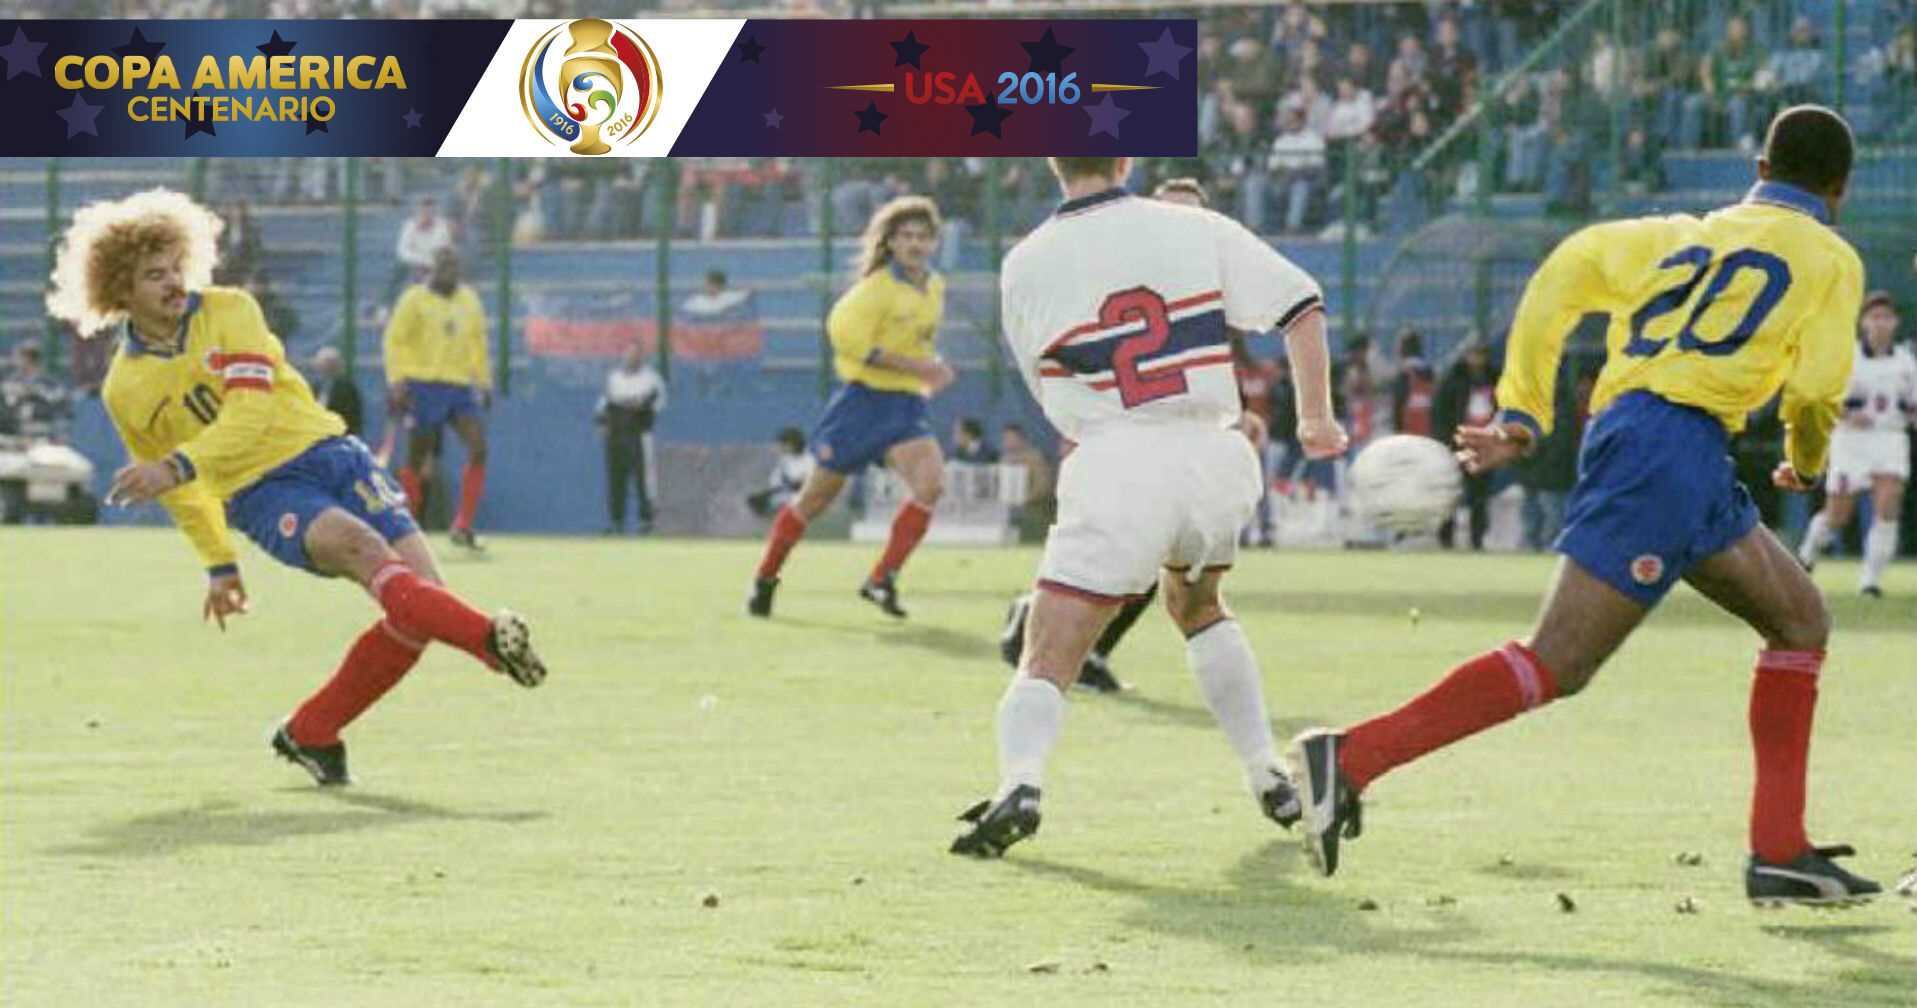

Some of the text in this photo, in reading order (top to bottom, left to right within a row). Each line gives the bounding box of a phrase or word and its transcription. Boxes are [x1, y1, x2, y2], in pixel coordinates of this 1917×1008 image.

[1099, 284, 1189, 410] 2
[1622, 245, 1792, 358] 20
[183, 383, 223, 425] 10
